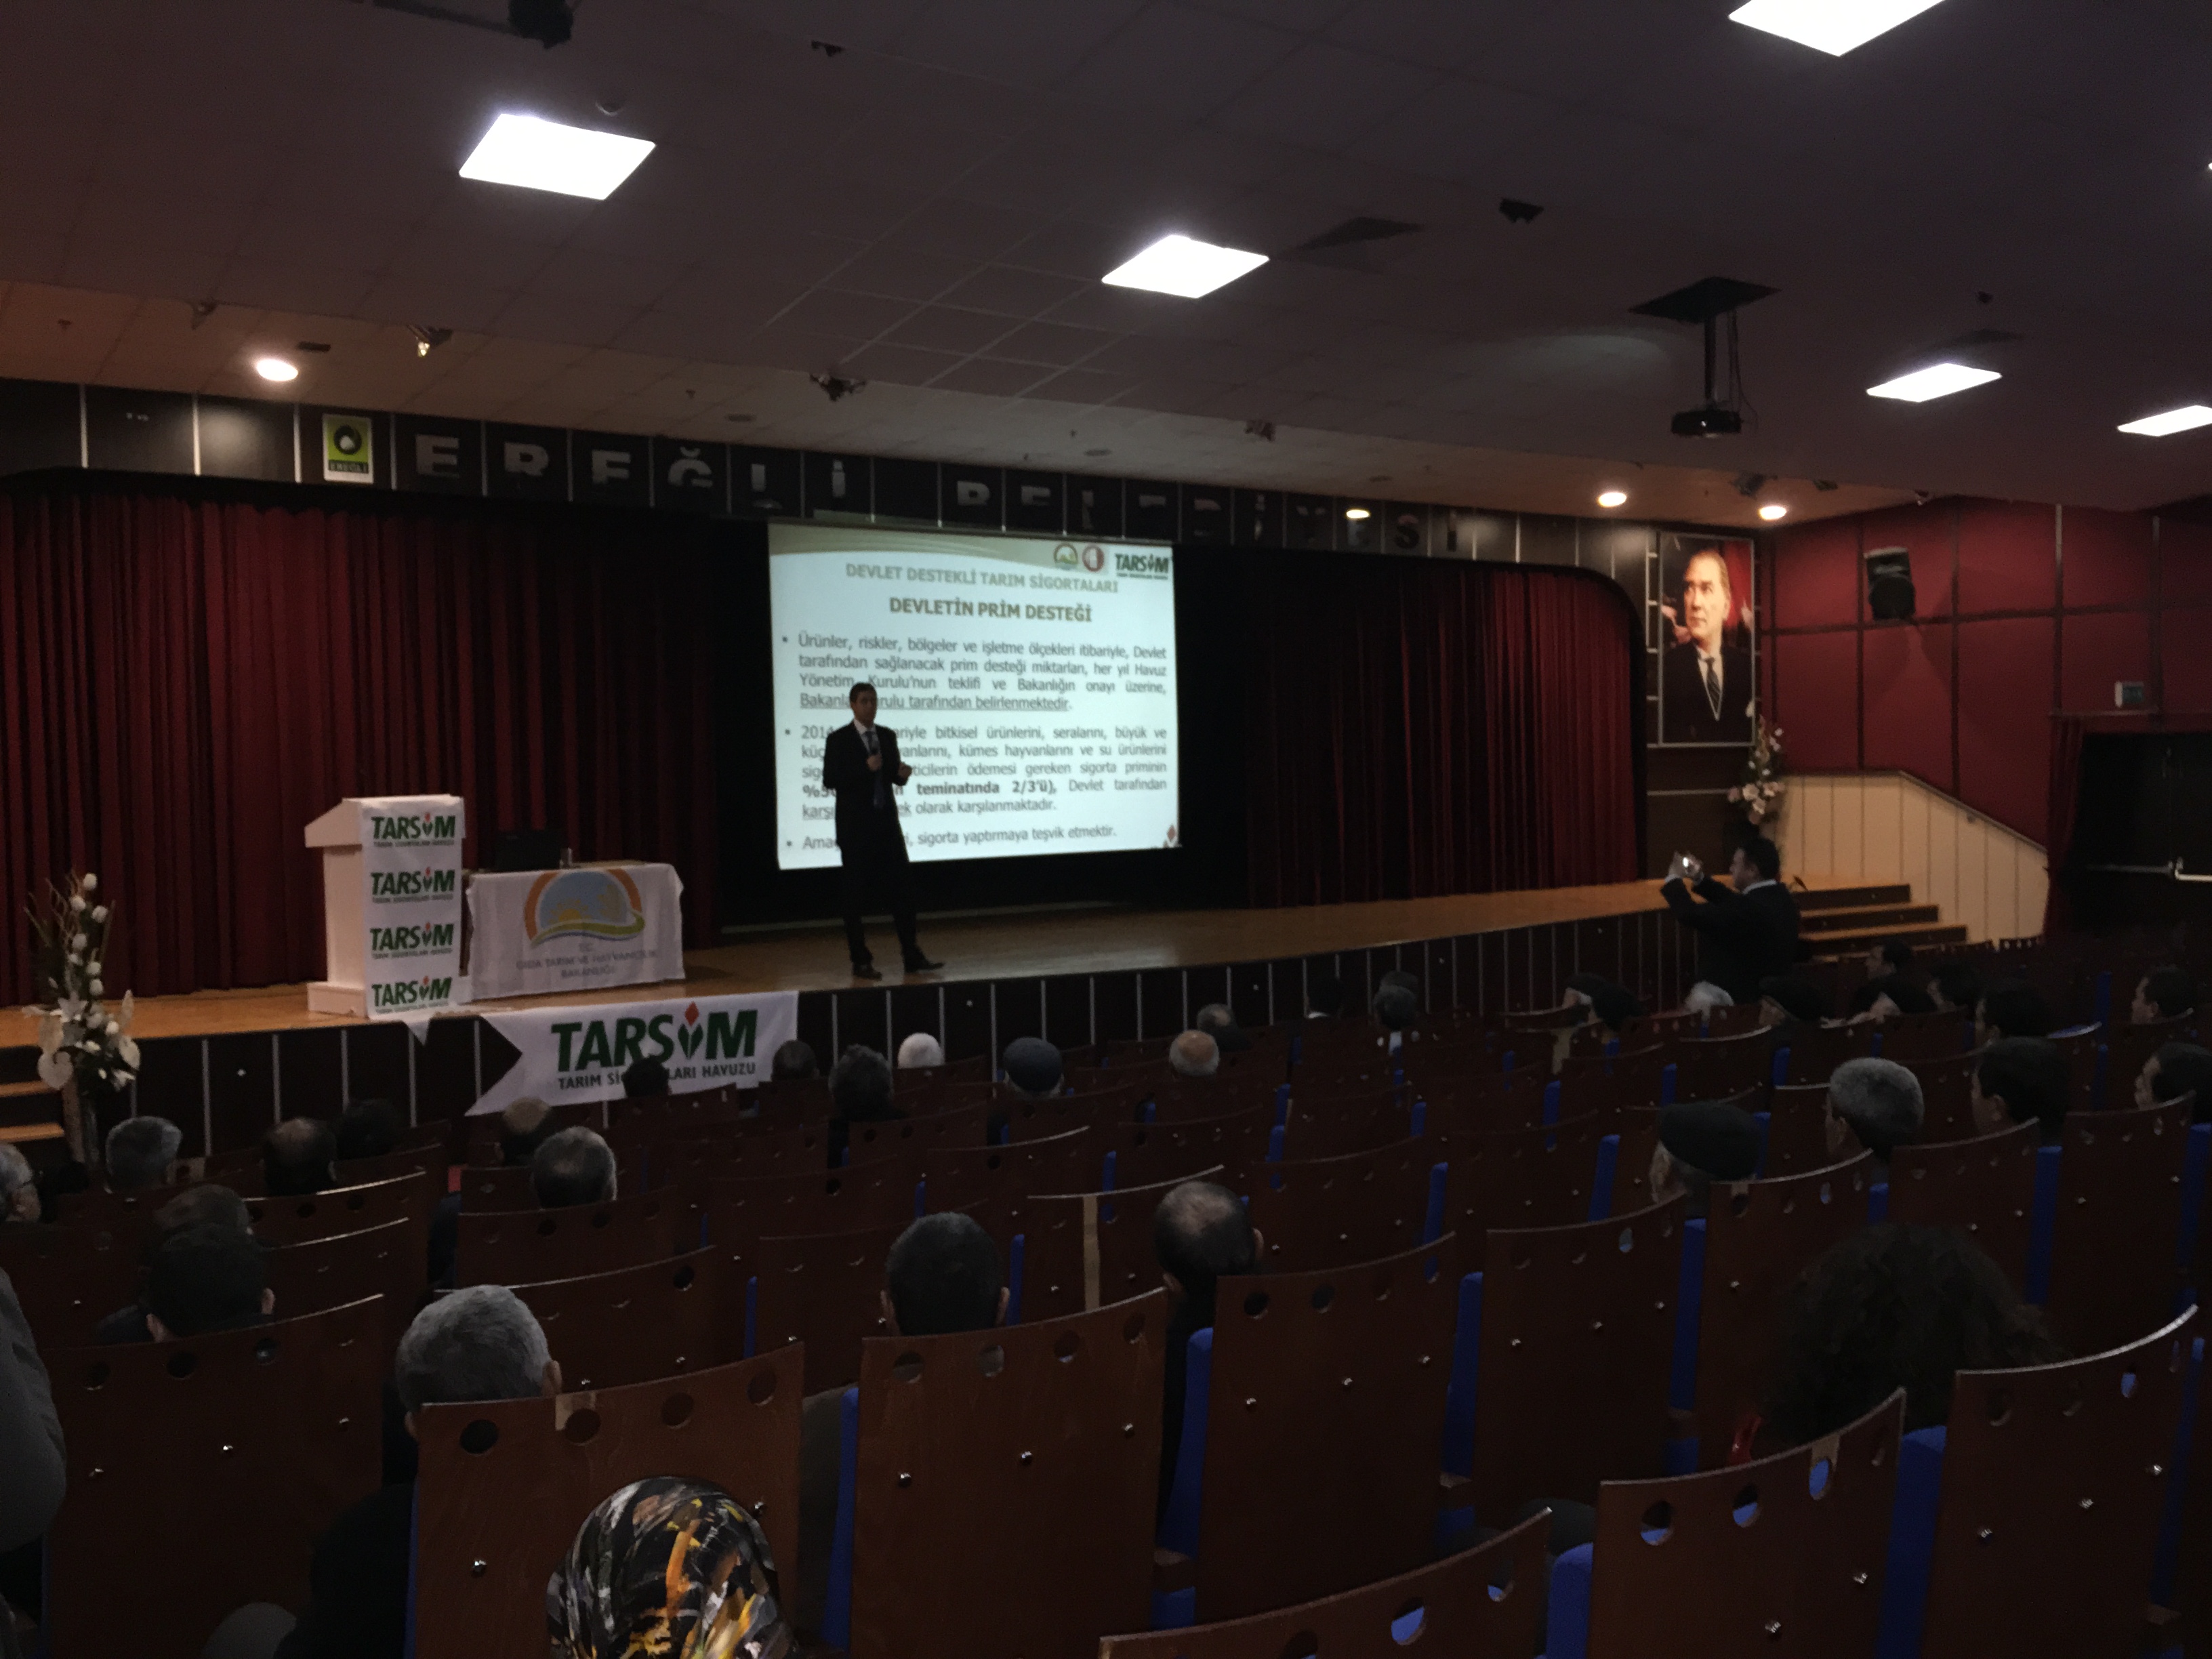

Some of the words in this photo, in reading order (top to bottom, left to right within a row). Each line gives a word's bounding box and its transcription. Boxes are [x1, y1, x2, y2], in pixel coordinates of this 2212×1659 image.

[846, 562, 903, 580] DEVLET
[907, 568, 975, 585] DESTEKLİ
[980, 571, 1025, 588] TARIM
[1029, 573, 1118, 593] SİGORTALARI
[890, 596, 973, 616] DEVLETİN
[978, 599, 1020, 619] PRİM
[1025, 602, 1092, 622] DESTEĞİ
[798, 630, 852, 651] Ürünler,
[859, 636, 903, 652] riskler,
[907, 637, 958, 654] bölgeler
[963, 642, 977, 653] ve
[982, 640, 1024, 656] işletme
[1029, 642, 1075, 657] ölçekleri
[1134, 645, 1166, 659] Devlet
[798, 654, 868, 668] tarafından
[874, 655, 945, 672] sağlanacak
[950, 658, 977, 672] prim
[984, 659, 1026, 675] desteği
[1094, 662, 1111, 674] her
[1135, 664, 1166, 676] Havuz
[800, 672, 854, 687] Yönetim
[868, 674, 937, 689] Kurulu'nun
[948, 676, 981, 689] teklifi
[992, 679, 1006, 690] ve
[1018, 677, 1076, 694] Bakanlığın
[1125, 681, 1166, 695] üzerine,
[800, 693, 851, 708] Bakanla
[935, 725, 978, 739] bitkisel
[987, 726, 1045, 740] ürünlerini,
[1115, 725, 1147, 741] büyük
[1154, 729, 1167, 739] ve
[959, 744, 998, 757] kümes
[1080, 746, 1093, 756] ve
[1099, 745, 1111, 756] su
[967, 763, 1017, 775] ödemesi
[1025, 762, 1071, 777] gereken
[1080, 762, 1116, 777] sigorta
[917, 781, 1000, 795] teminatında
[1069, 779, 1104, 792] Devlet
[916, 801, 954, 814] olarak
[371, 811, 455, 839] TARSİM
[918, 832, 958, 847] sigorta
[1032, 826, 1064, 842] teşvik
[1068, 825, 1116, 840] etmektir.
[371, 867, 455, 895] TARSİM
[369, 922, 453, 951] TARSİM
[371, 976, 452, 1006] TARSİM
[551, 1001, 758, 1072] TARSİM
[558, 1073, 601, 1090] TARIM
[702, 1062, 756, 1078] HAVUZU
